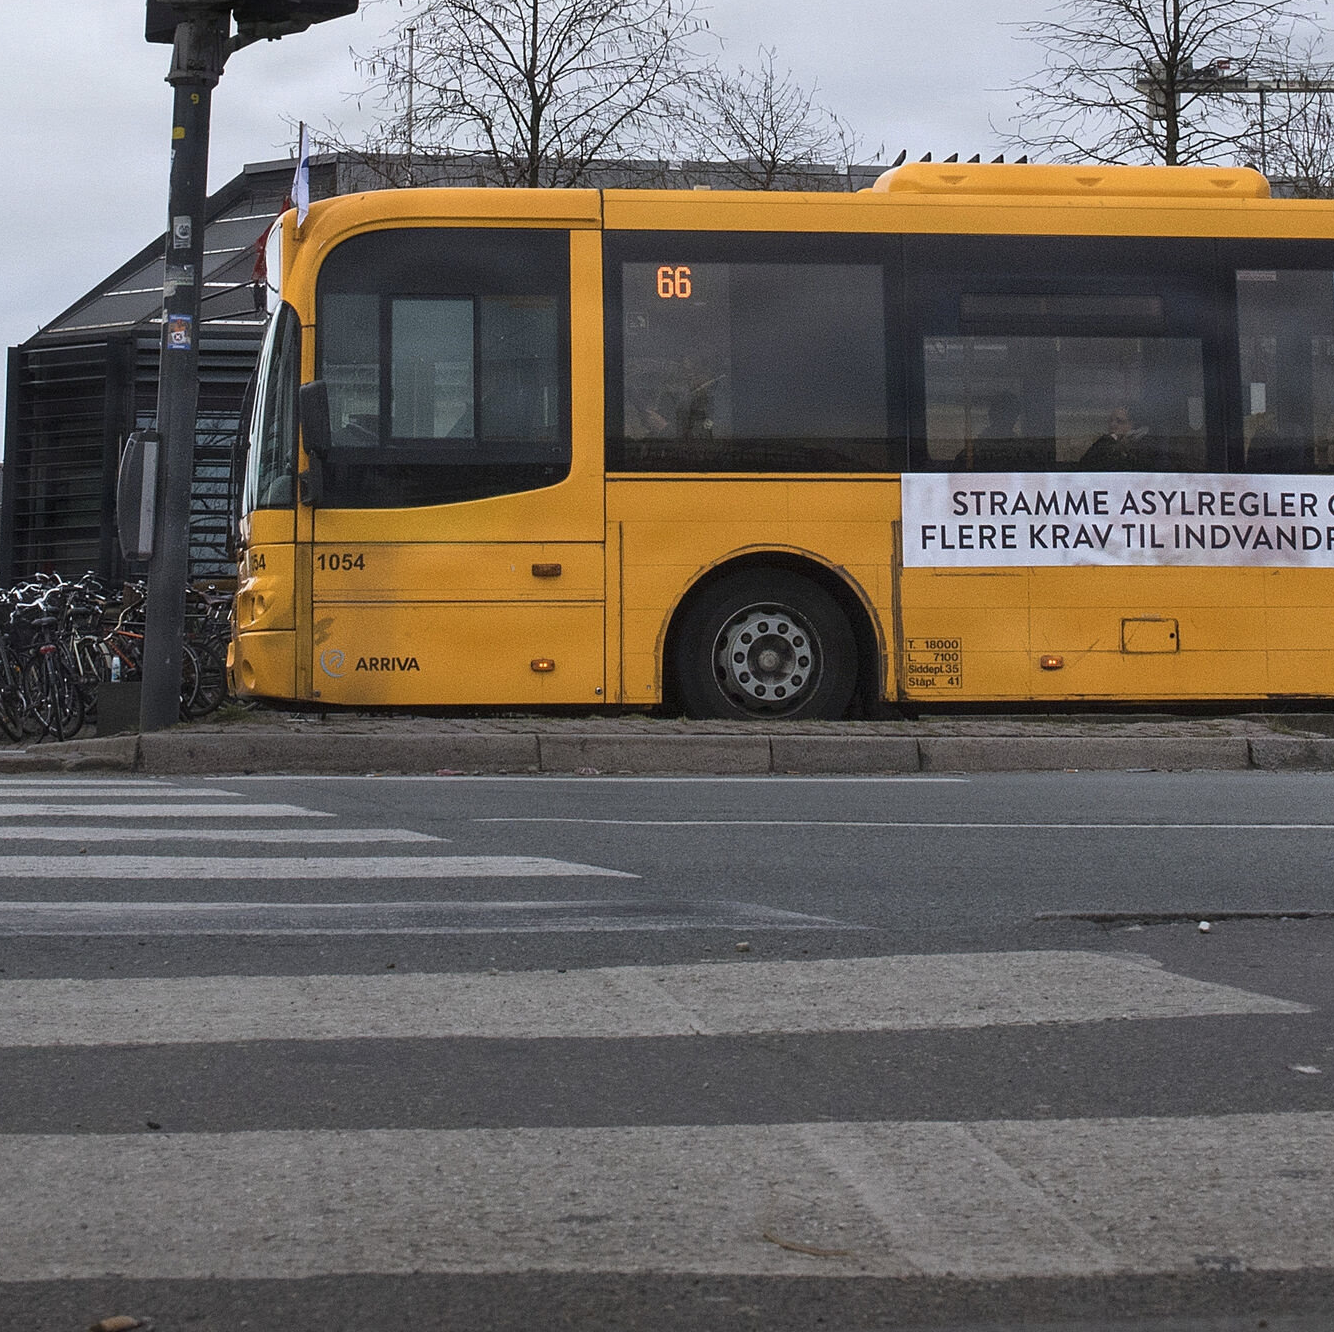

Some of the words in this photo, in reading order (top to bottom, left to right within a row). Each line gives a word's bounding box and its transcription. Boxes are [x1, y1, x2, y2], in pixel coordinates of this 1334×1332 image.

[657, 266, 692, 298] 66
[953, 490, 1109, 516] STRAMME
[1120, 490, 1318, 517] ASYLREGLER
[921, 524, 1018, 550] FLERE
[1029, 523, 1114, 549] KRAV
[1122, 523, 1165, 549] TIL
[317, 553, 366, 571] 1054
[908, 639, 916, 649] T.
[924, 639, 959, 649] 18000
[355, 657, 421, 672] ARRIVA
[908, 653, 917, 662] L.
[933, 652, 959, 662] 7100
[945, 664, 959, 674] 35
[947, 676, 959, 686] 41
